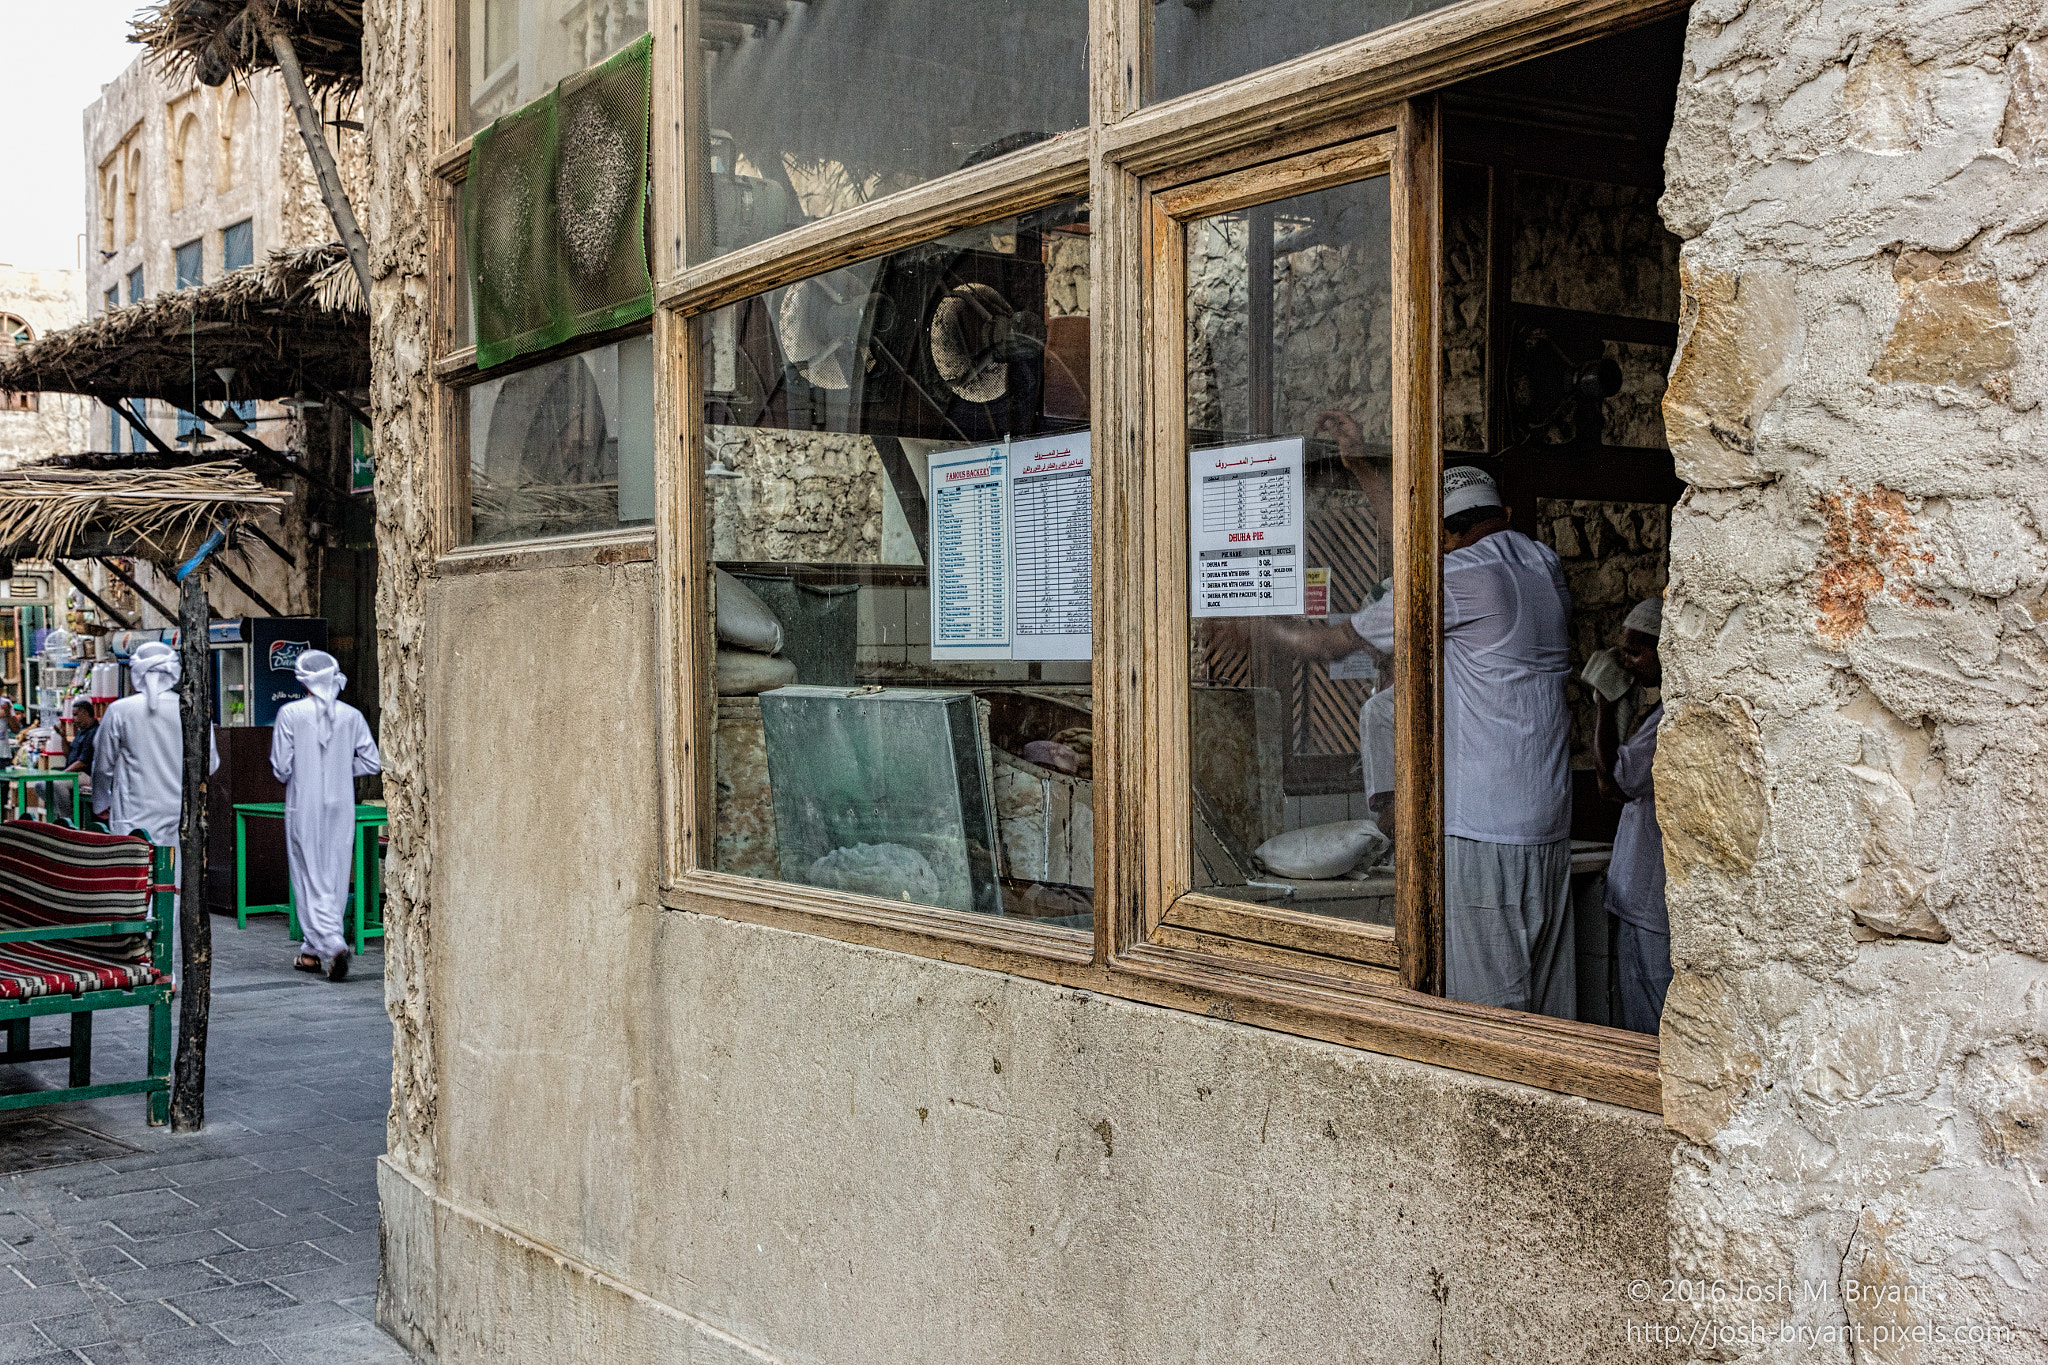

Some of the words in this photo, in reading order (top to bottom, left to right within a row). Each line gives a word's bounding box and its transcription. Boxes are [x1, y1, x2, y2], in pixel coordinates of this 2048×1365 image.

[946, 470, 966, 479] FAMOUS
[1228, 533, 1251, 542] DHUHA
[1252, 532, 1264, 540] PIE
